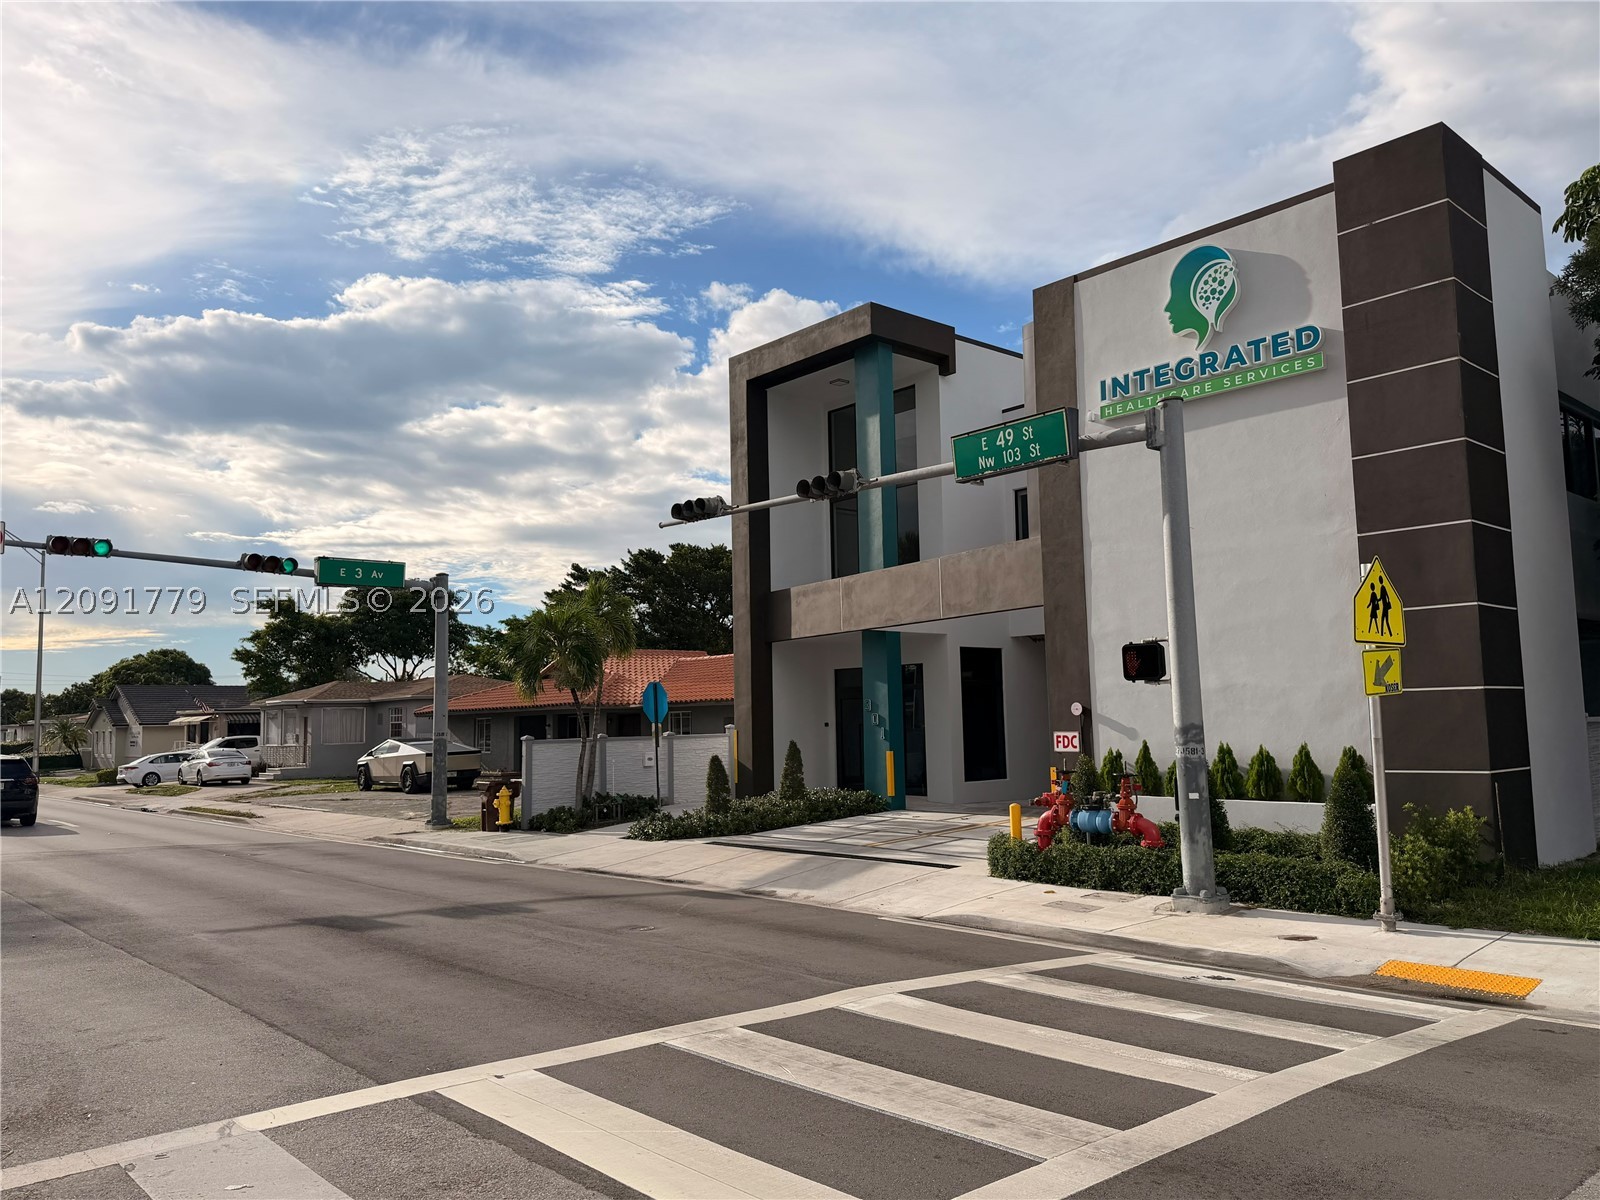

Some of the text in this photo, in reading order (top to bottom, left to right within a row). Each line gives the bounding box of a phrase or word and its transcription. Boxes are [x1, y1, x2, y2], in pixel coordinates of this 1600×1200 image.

[1099, 325, 1323, 401] INTEGRATED
[1223, 357, 1316, 388] SERVICES
[981, 425, 1034, 451] E 49 St
[978, 442, 1041, 469] Nw 103 St
[340, 568, 384, 579] E 3 Av
[1055, 734, 1078, 749] FDC
